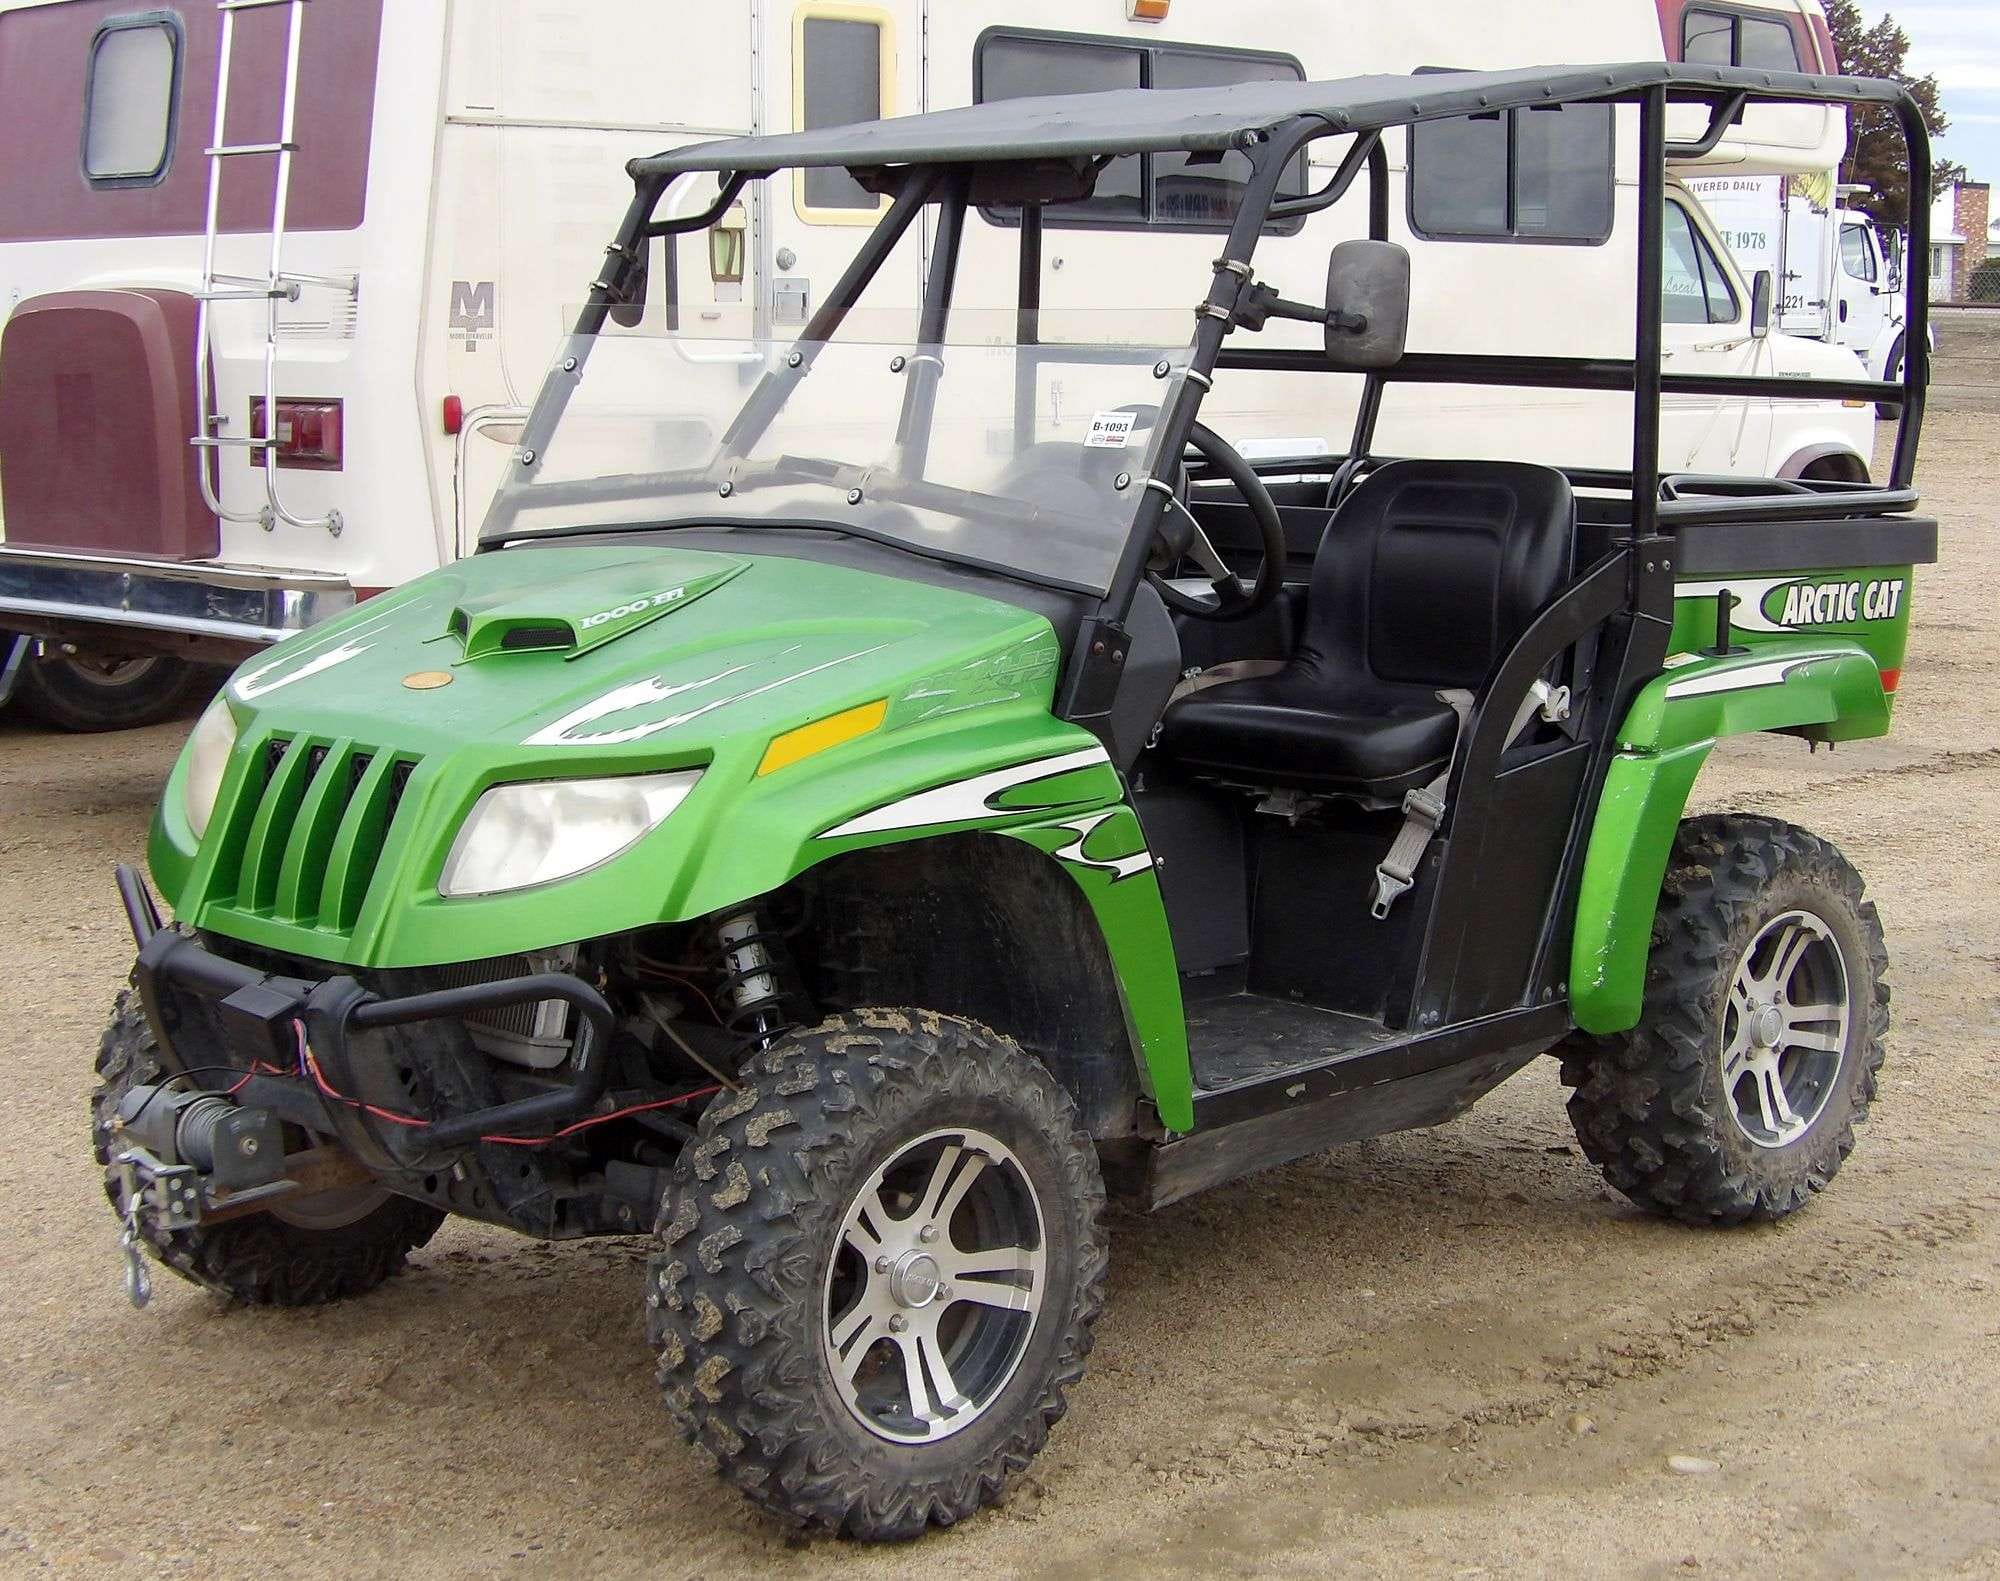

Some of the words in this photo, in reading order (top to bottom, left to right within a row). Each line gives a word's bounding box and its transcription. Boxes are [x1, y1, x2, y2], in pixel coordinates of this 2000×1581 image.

[1733, 181, 1762, 192] DAILY
[1735, 231, 1766, 250] 1978
[1664, 274, 1697, 294] Local
[1785, 295, 1803, 309] 221
[1093, 421, 1129, 432] B-1093
[1779, 581, 1861, 627] ARCTIC
[1862, 578, 1904, 621] CAT
[579, 599, 650, 630] 1000
